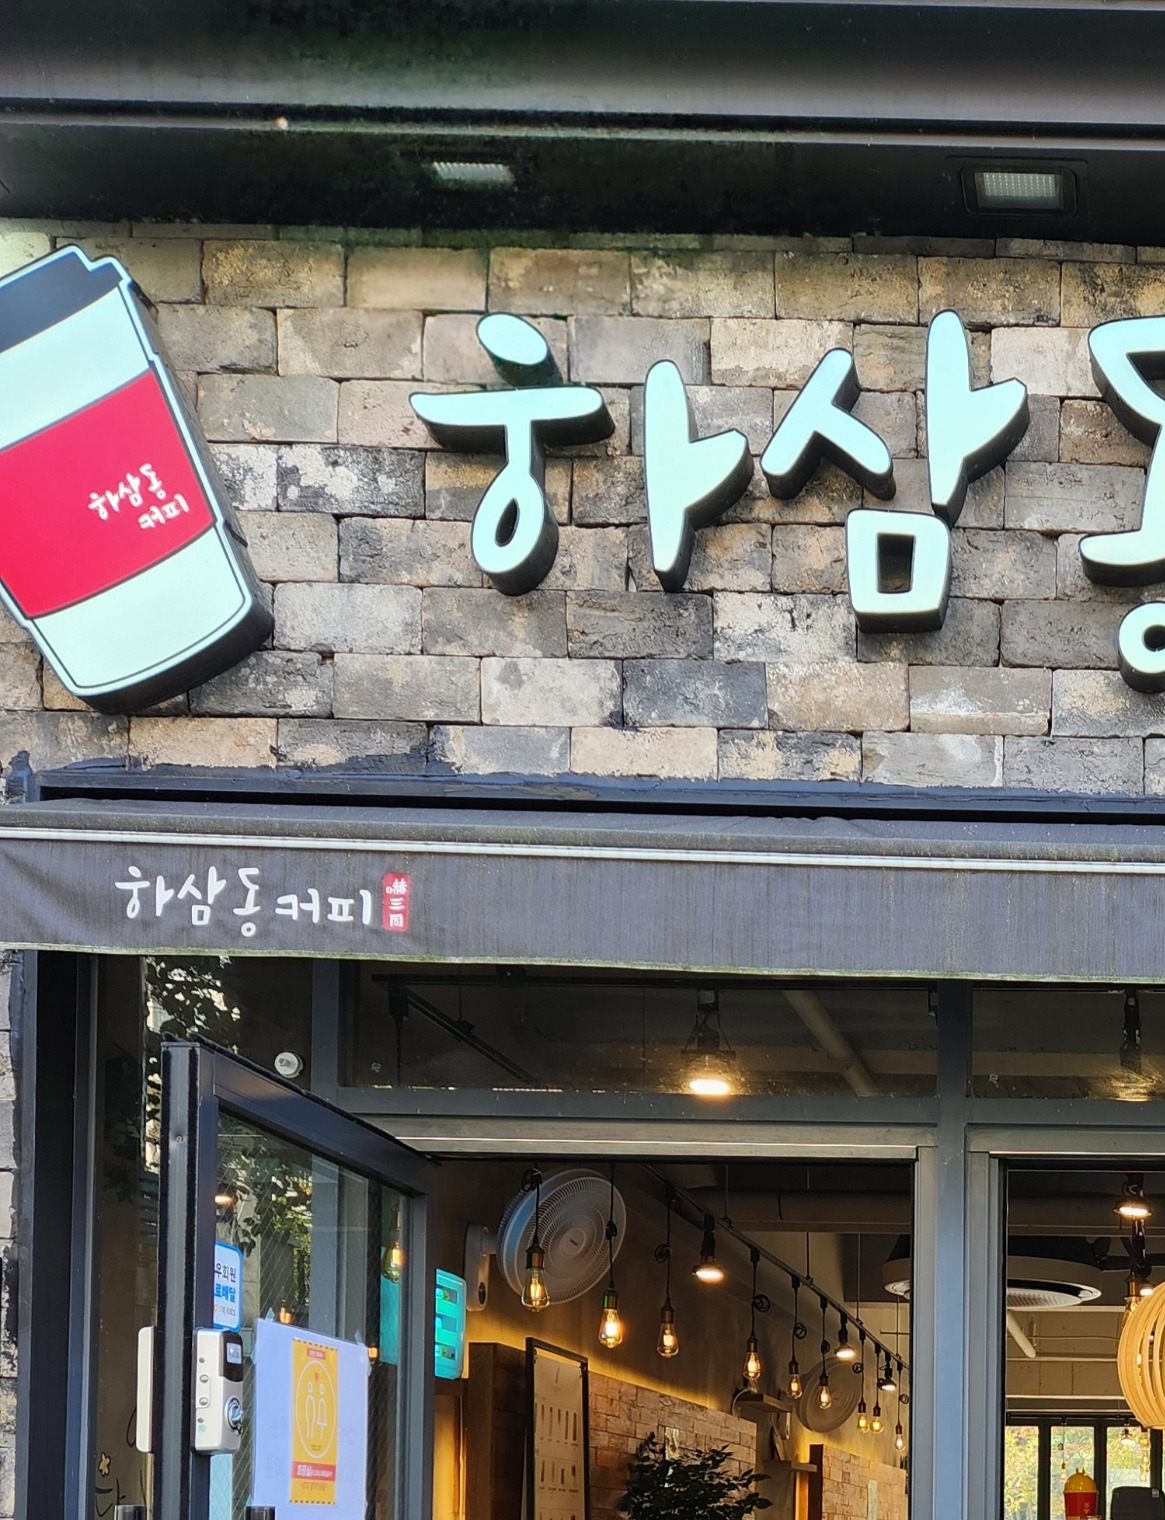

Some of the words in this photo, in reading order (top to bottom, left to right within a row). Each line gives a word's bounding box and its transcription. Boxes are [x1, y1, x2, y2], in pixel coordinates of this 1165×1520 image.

[87, 462, 167, 521] 하삼동
[137, 493, 190, 529] 커피
[115, 866, 261, 938] 하삼동
[275, 888, 373, 927] 커피
